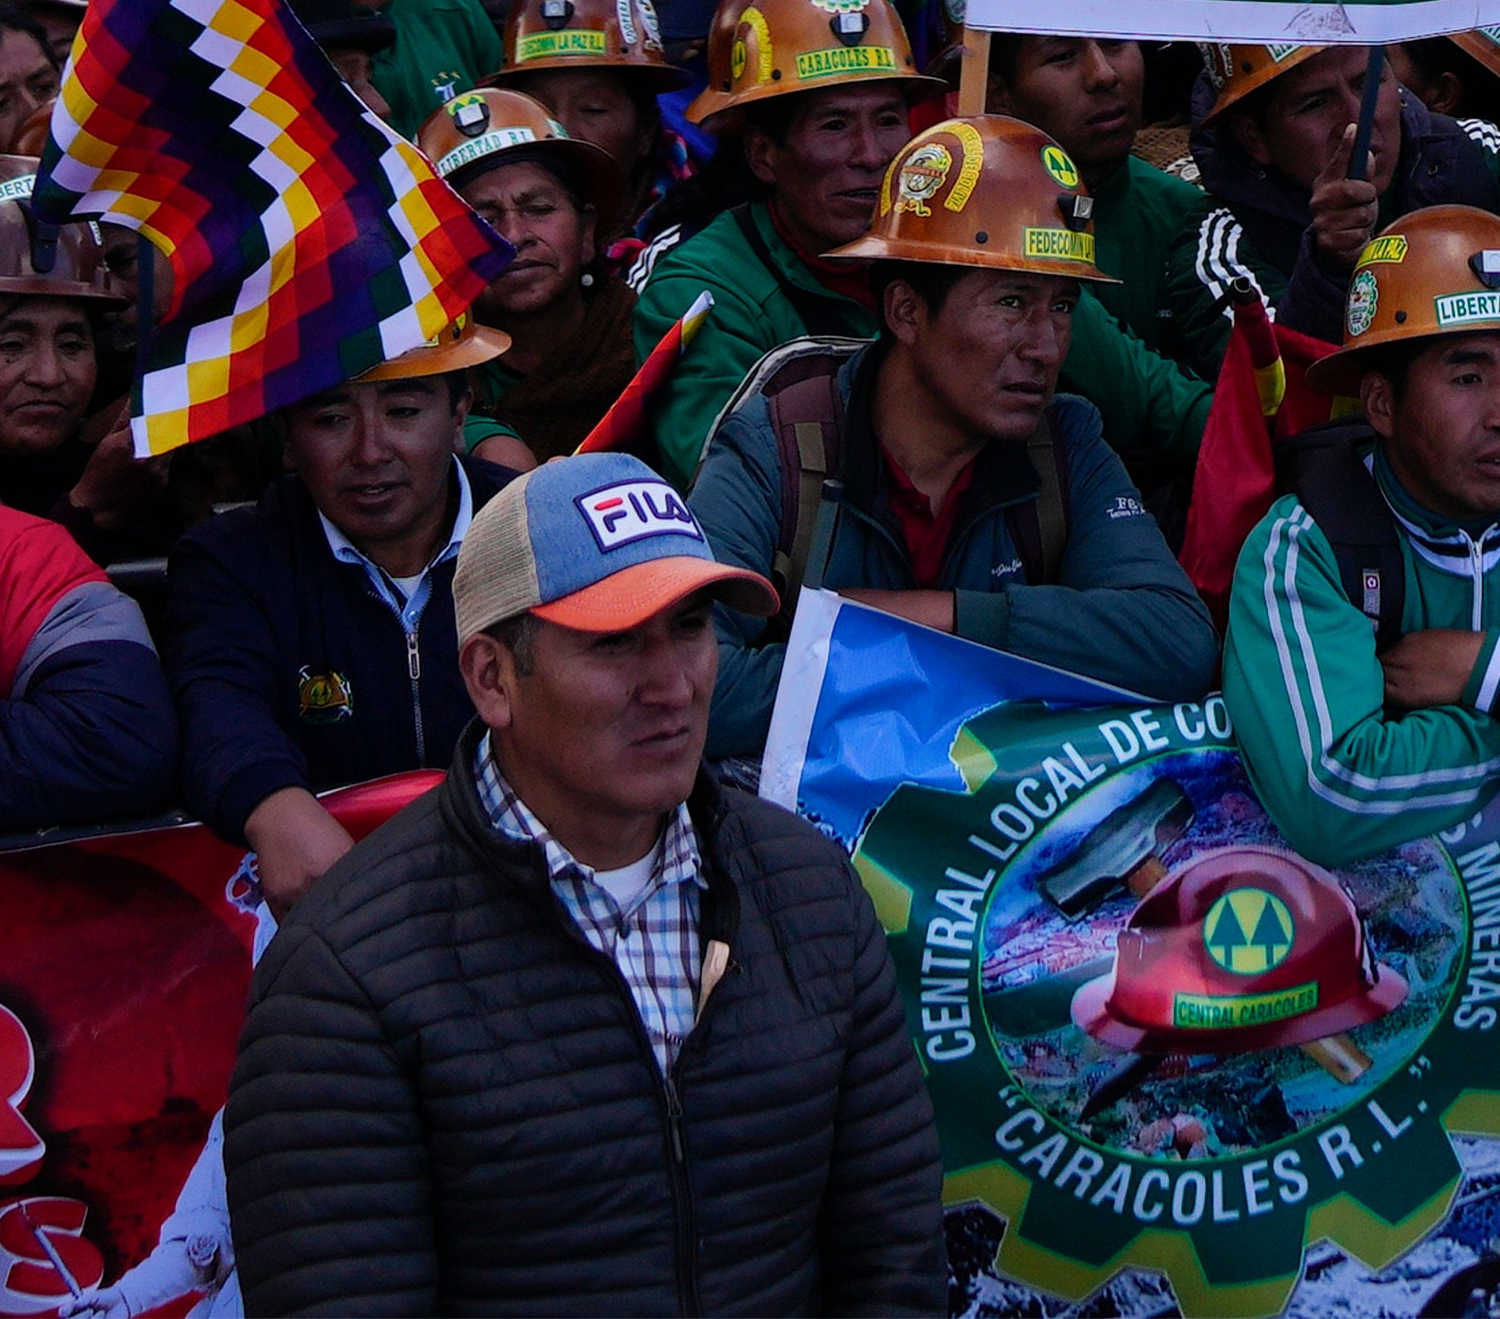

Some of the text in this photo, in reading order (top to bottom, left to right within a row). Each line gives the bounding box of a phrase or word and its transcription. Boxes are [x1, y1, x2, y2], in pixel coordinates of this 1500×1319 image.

[799, 49, 871, 78] CARACOLES
[439, 131, 504, 177] LIBERTAD
[593, 490, 693, 533] FILA
[921, 875, 996, 1064] CENTRAL
[970, 742, 1102, 859] LOCAL
[1105, 702, 1175, 760] DE
[1178, 988, 1317, 1026] CENTRAL CARACOLES
